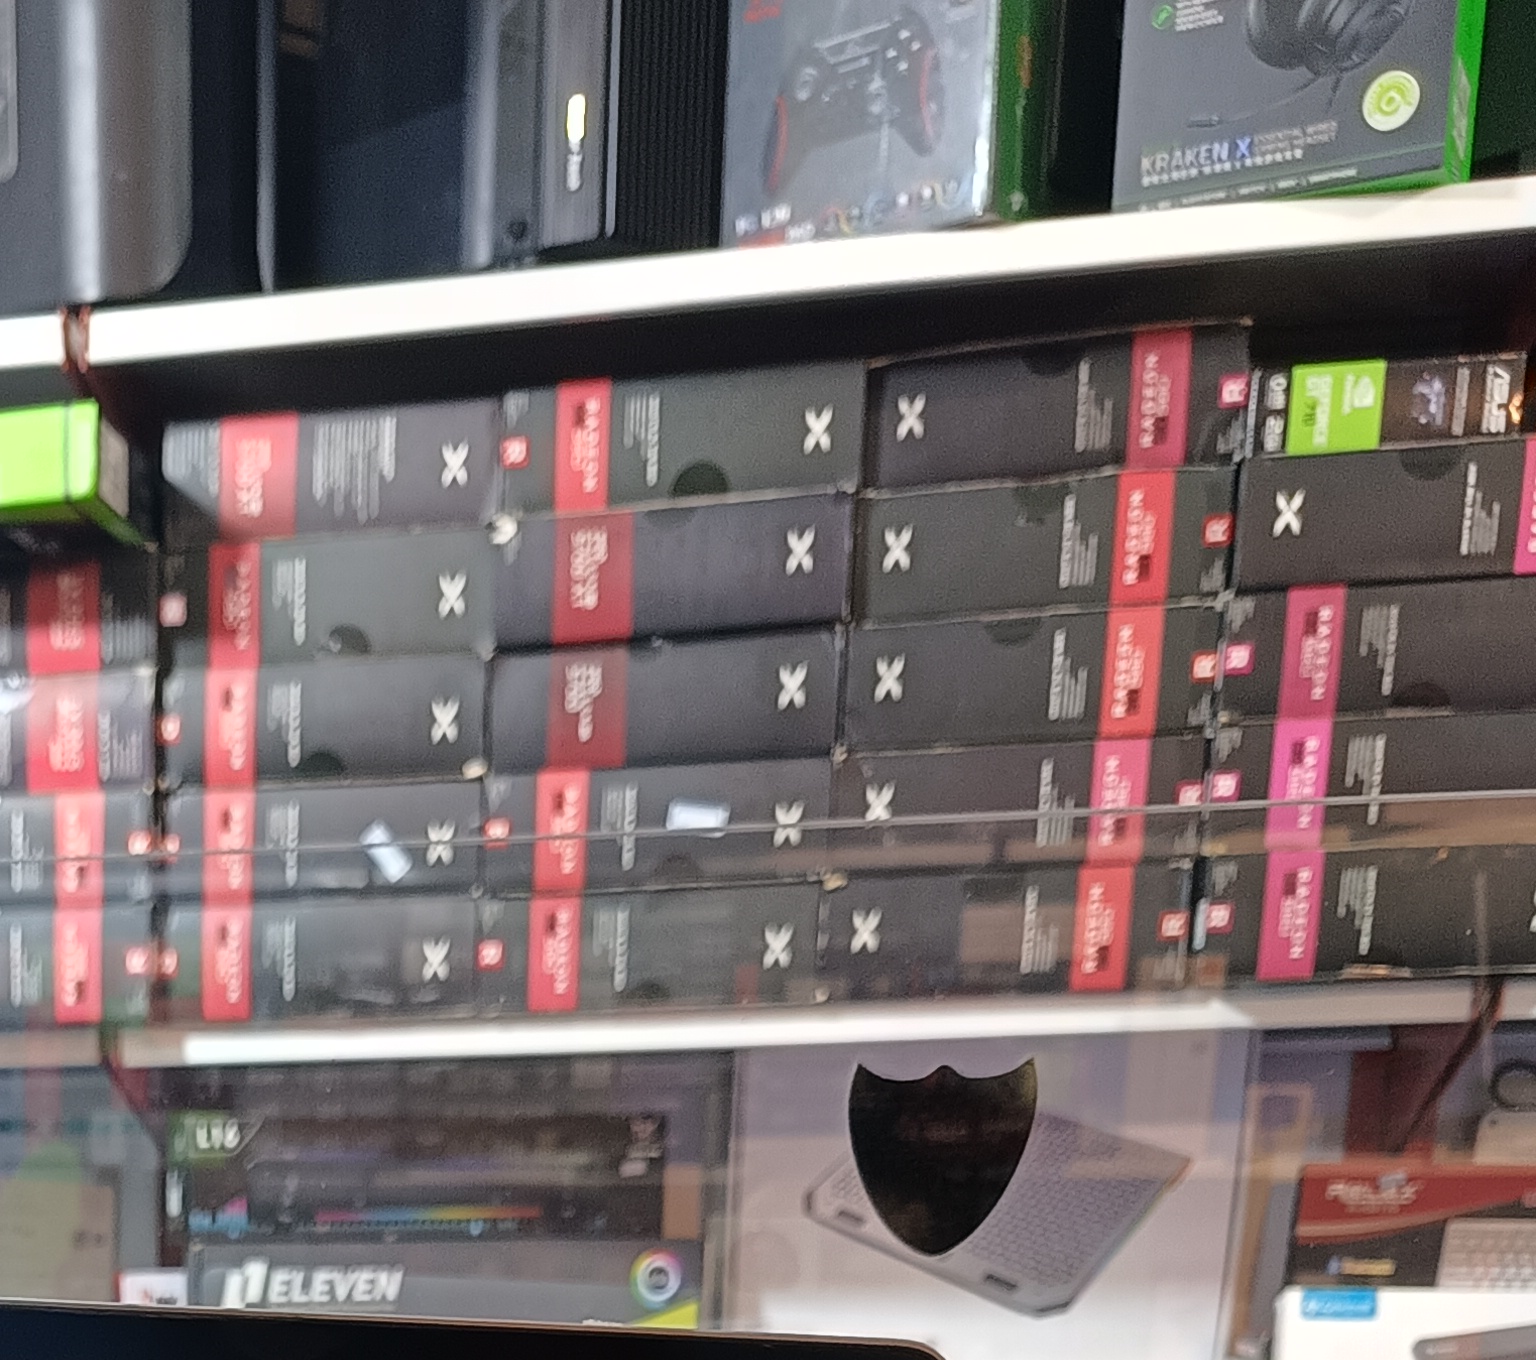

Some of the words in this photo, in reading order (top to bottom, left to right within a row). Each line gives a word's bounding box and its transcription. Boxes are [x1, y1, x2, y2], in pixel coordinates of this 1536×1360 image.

[1140, 141, 1229, 176] KRAKEN
[1235, 135, 1255, 160] X
[267, 1263, 405, 1305] ELEVEN
